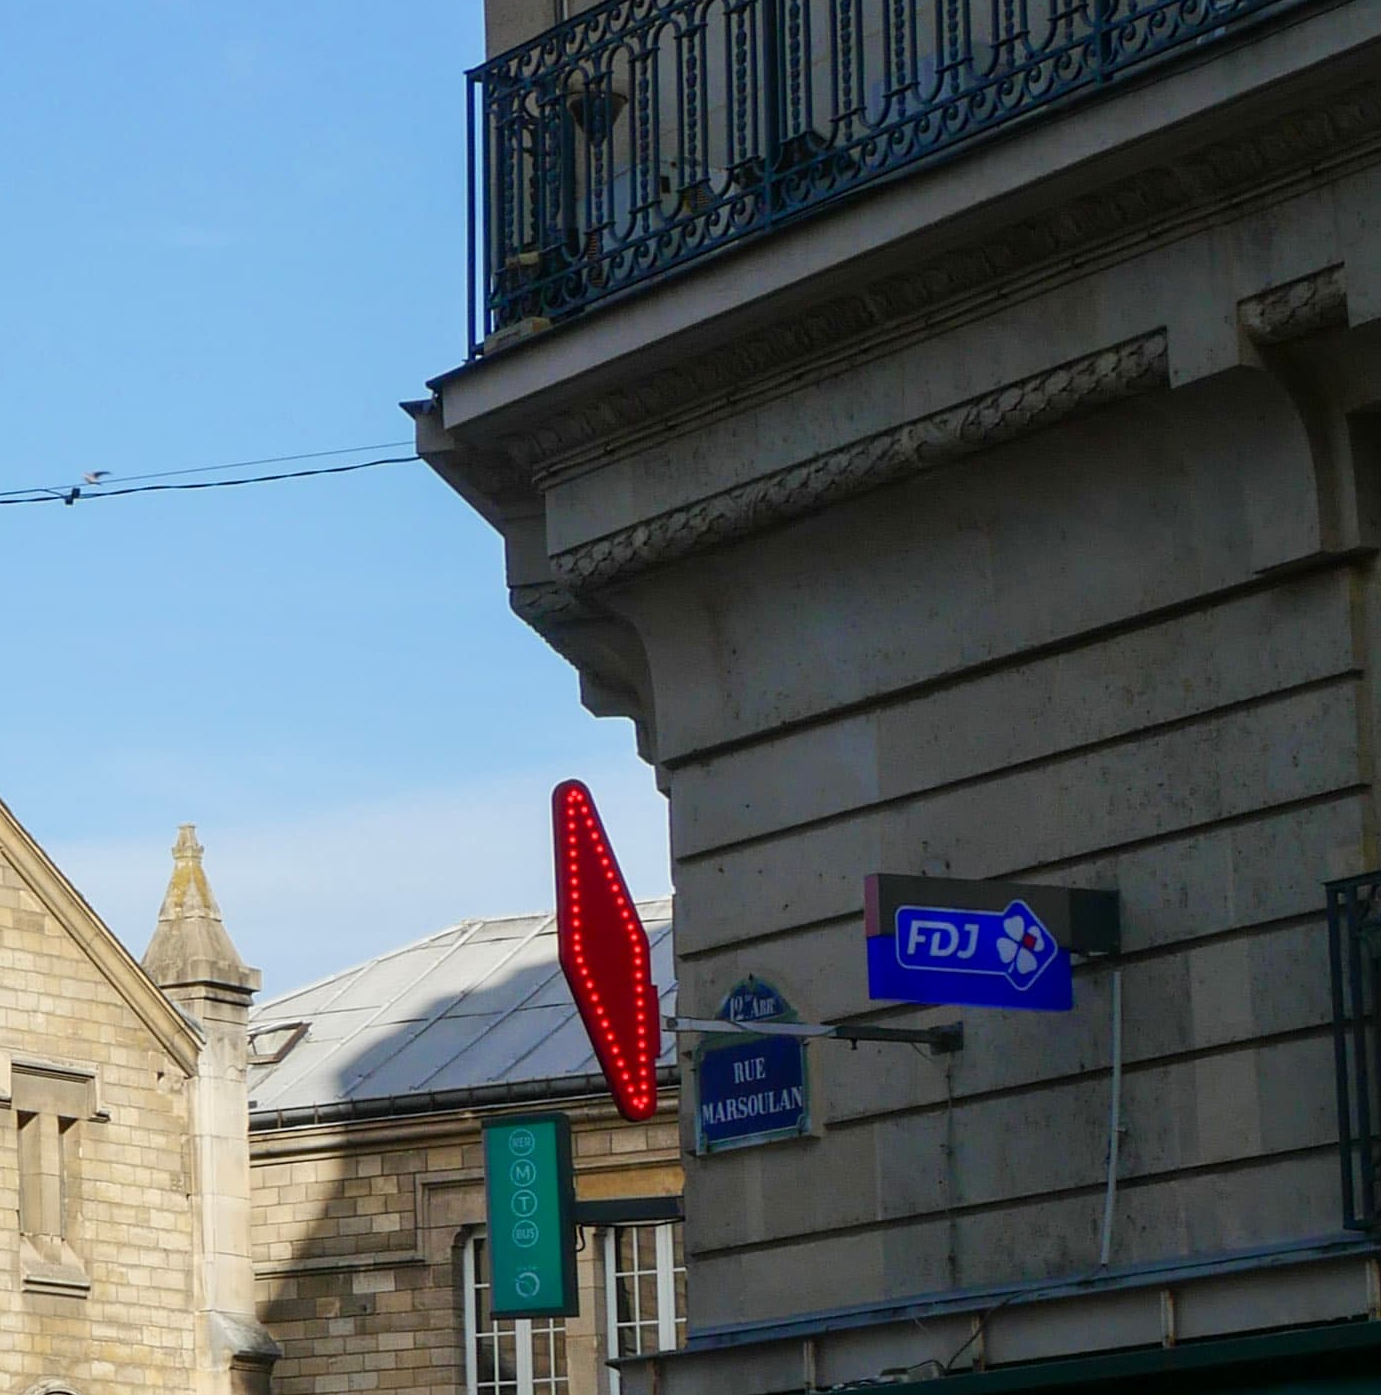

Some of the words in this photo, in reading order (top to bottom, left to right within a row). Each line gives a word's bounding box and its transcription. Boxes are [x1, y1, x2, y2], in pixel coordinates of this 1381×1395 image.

[907, 919, 980, 959] FDJ
[733, 1057, 766, 1084] RUE
[702, 1086, 803, 1125] MARSOULAN
[515, 1165, 530, 1181] M
[518, 1196, 530, 1211] T
[516, 1227, 535, 1240] BUS
